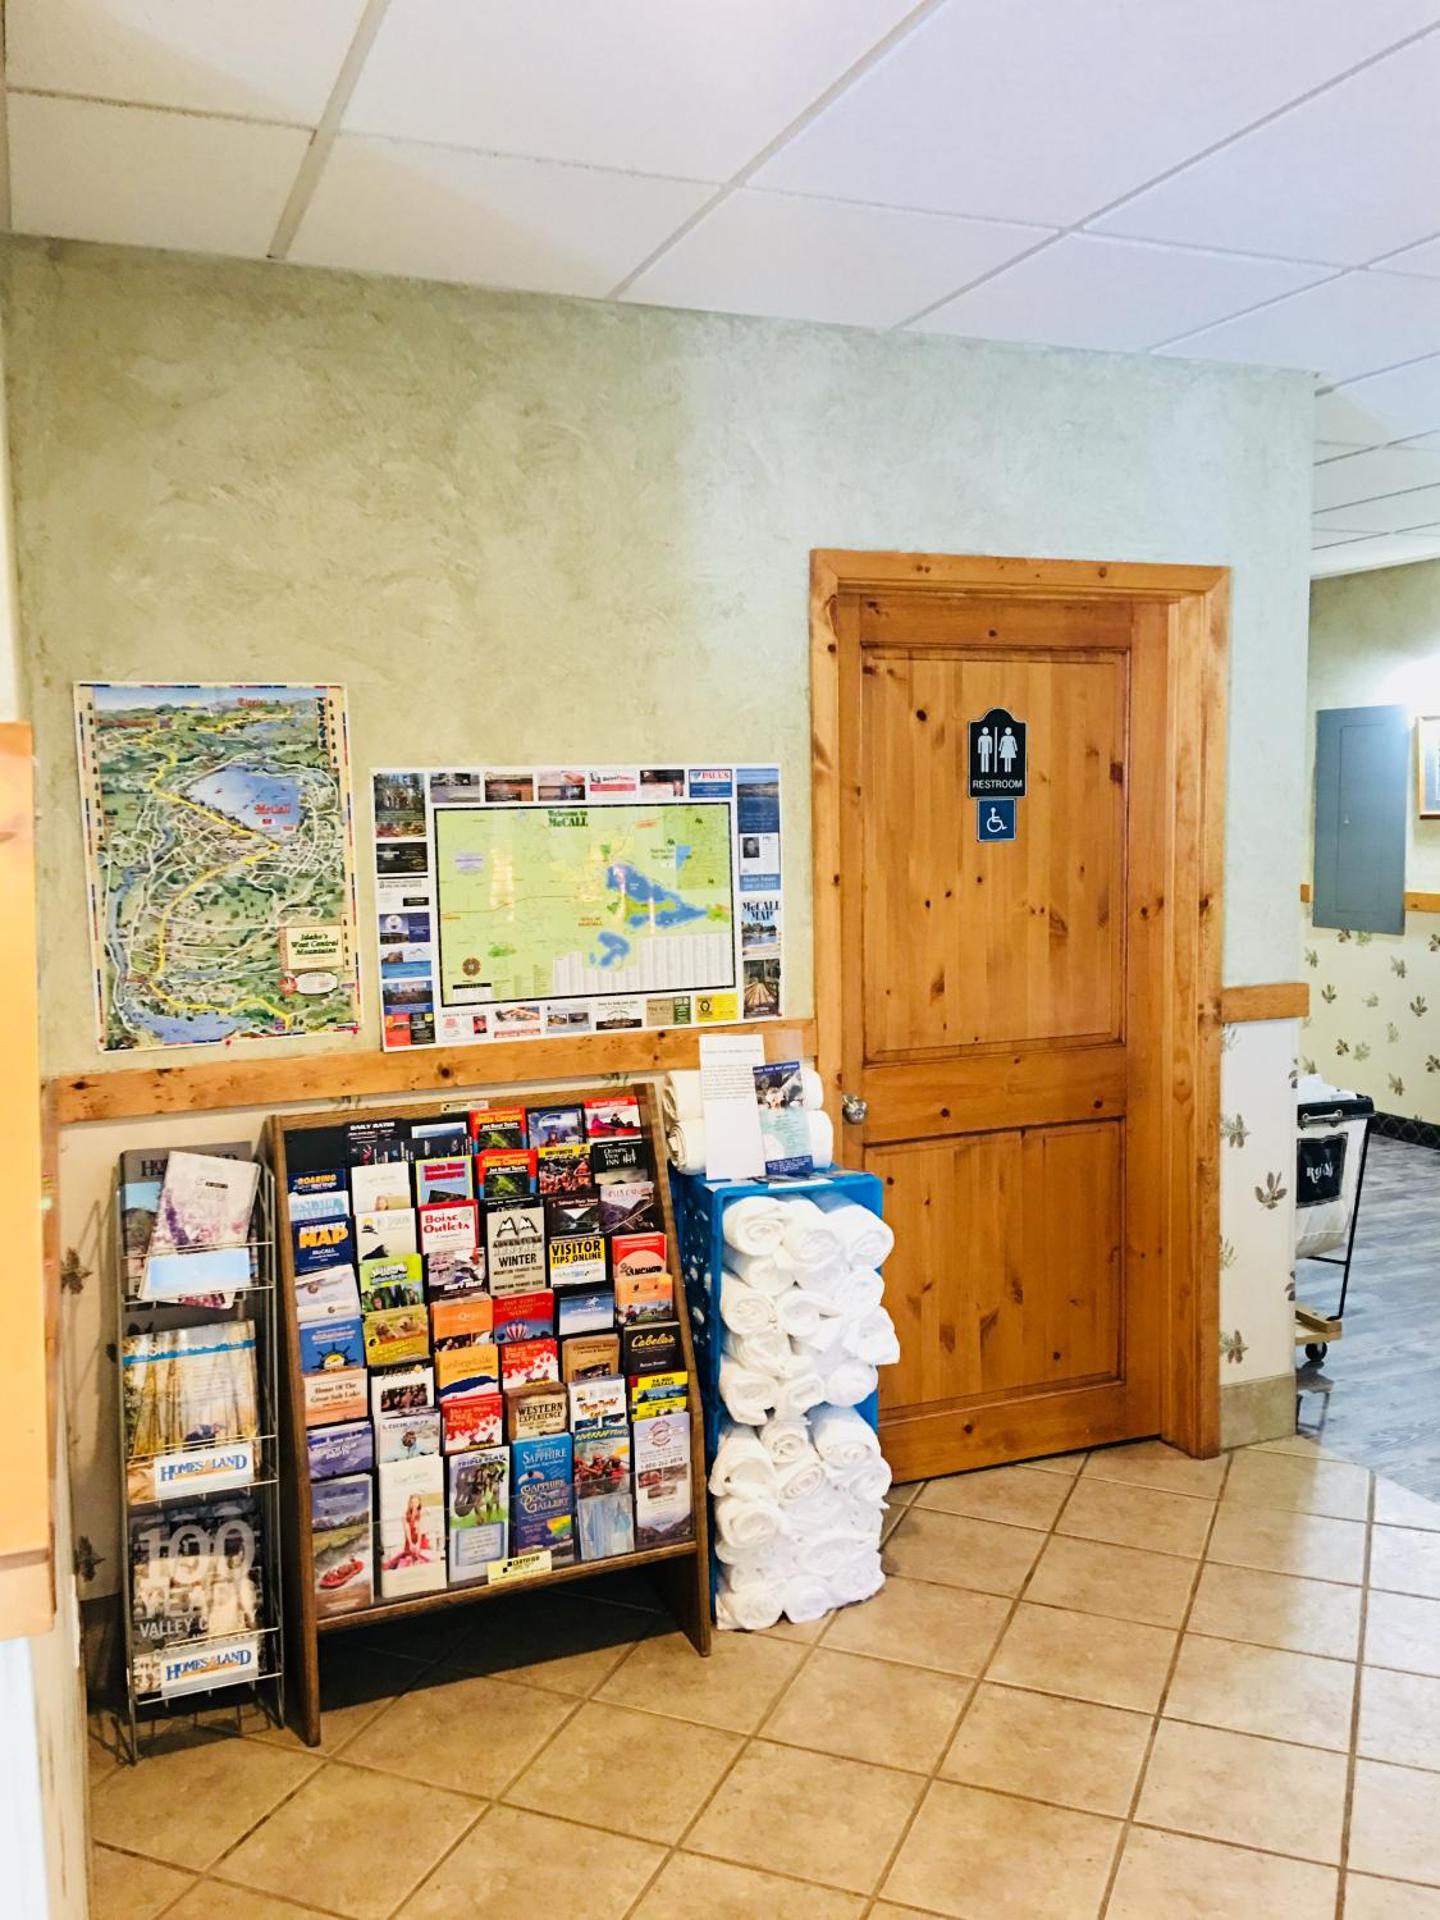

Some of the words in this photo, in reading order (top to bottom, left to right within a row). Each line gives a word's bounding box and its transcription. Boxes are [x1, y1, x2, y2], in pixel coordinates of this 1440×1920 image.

[973, 780, 1023, 789] RESTROOM
[742, 900, 781, 912] McCALL
[751, 910, 774, 921] MAP
[424, 1213, 459, 1224] Boise
[423, 1221, 471, 1234] Outlets
[298, 1226, 349, 1249] MAP
[551, 1240, 601, 1256] VISITOR
[498, 1253, 537, 1268] WINTER
[552, 1256, 569, 1265] TIPS
[572, 1252, 602, 1263] ONLINE
[517, 1403, 563, 1417] WESTERN
[518, 1411, 562, 1423] EXPERIENCE
[211, 1454, 248, 1472] LAND
[522, 1447, 567, 1466] SAPPHIRE
[524, 1496, 569, 1514] GALLERY
[139, 1617, 194, 1639] VALLEY
[216, 1649, 252, 1666] LAND
